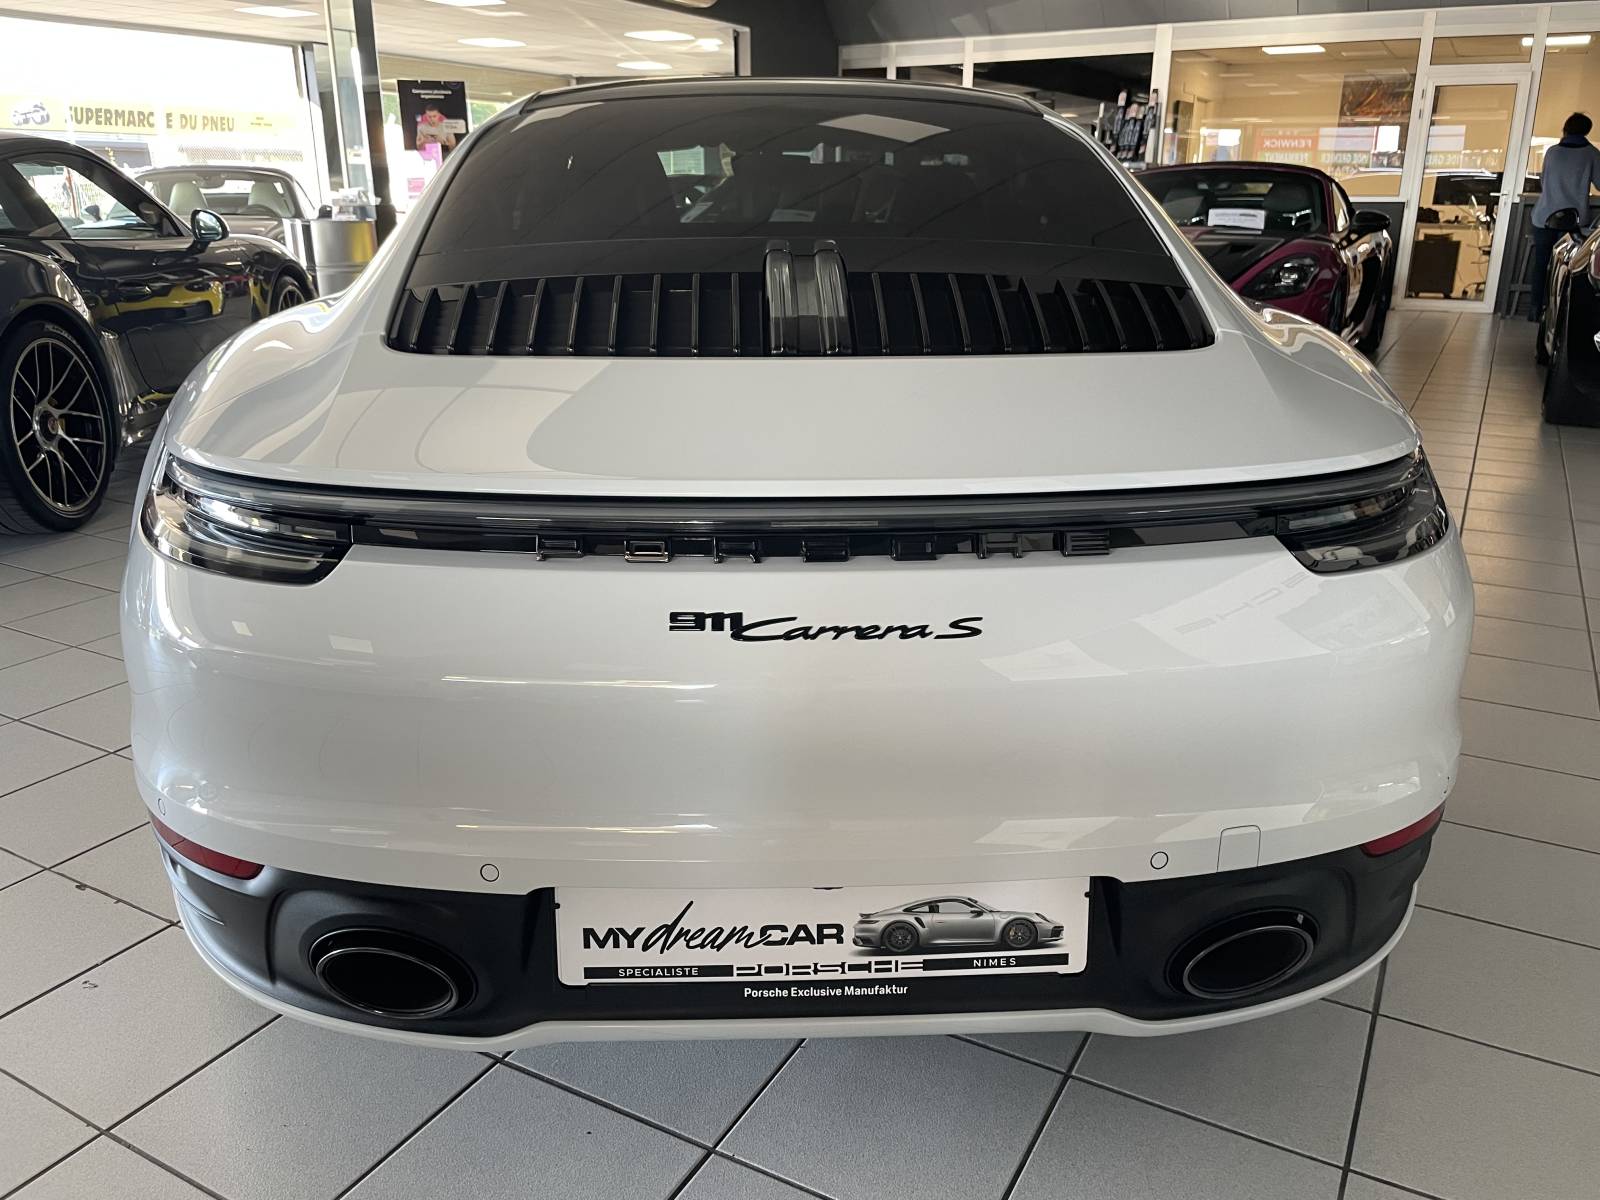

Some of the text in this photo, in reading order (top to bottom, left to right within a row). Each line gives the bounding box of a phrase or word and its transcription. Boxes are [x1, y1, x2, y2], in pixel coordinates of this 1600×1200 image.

[66, 106, 173, 129] UPERMARCE
[180, 114, 198, 131] DU
[202, 115, 235, 132] PNEU
[535, 529, 1111, 564] PORSCHE
[668, 611, 983, 642] 911 Carrera S
[618, 957, 1016, 977] SPECIALISTE PORSCHE NIMES
[744, 984, 909, 998] Porsche Exclusive Manufaktur
